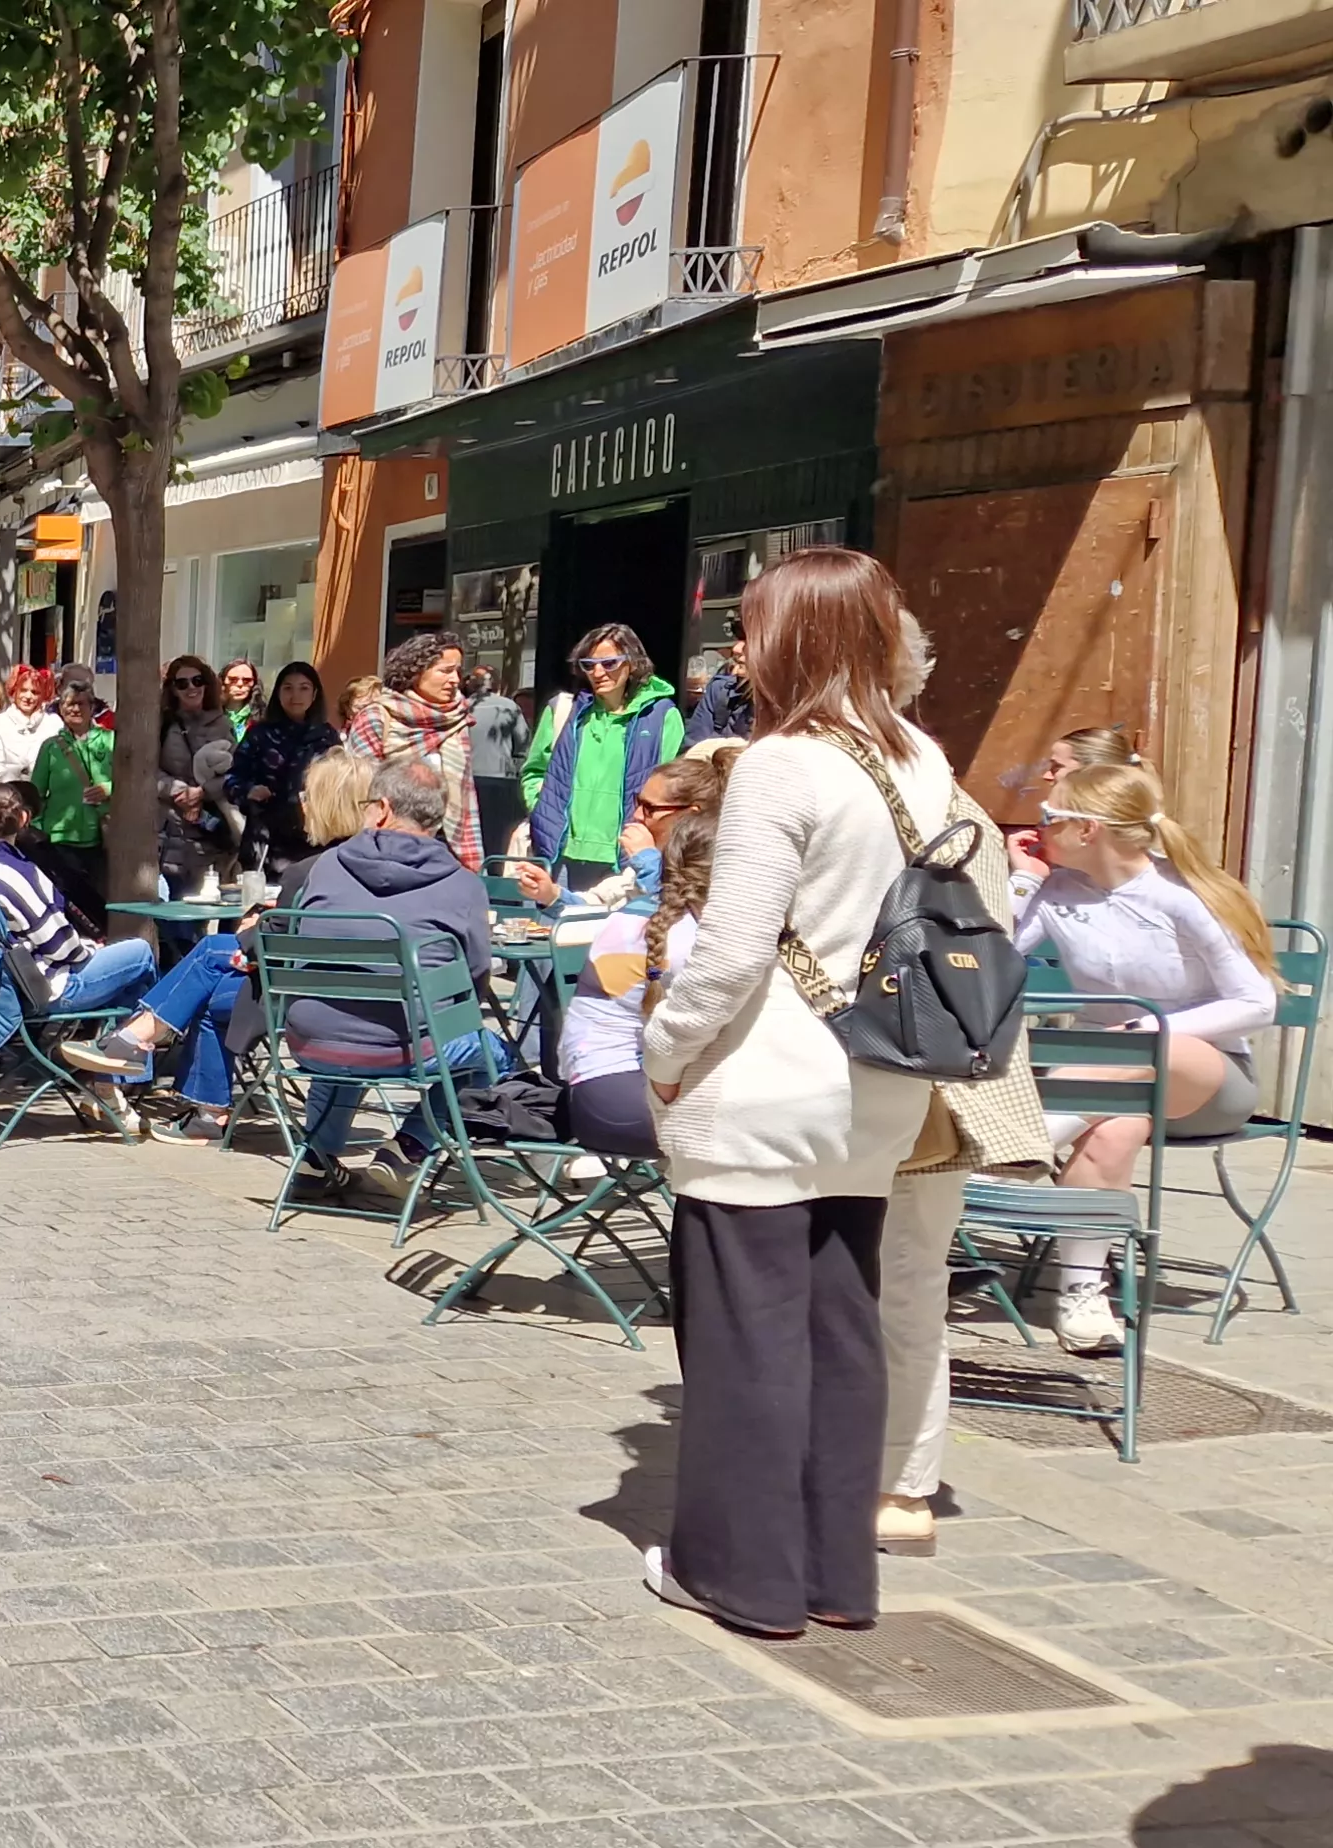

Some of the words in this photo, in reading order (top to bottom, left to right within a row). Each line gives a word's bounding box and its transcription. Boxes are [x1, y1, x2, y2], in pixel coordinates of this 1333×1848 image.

[598, 228, 658, 278] REPSOL
[384, 338, 426, 369] REPSOL
[39, 549, 78, 559] orange
